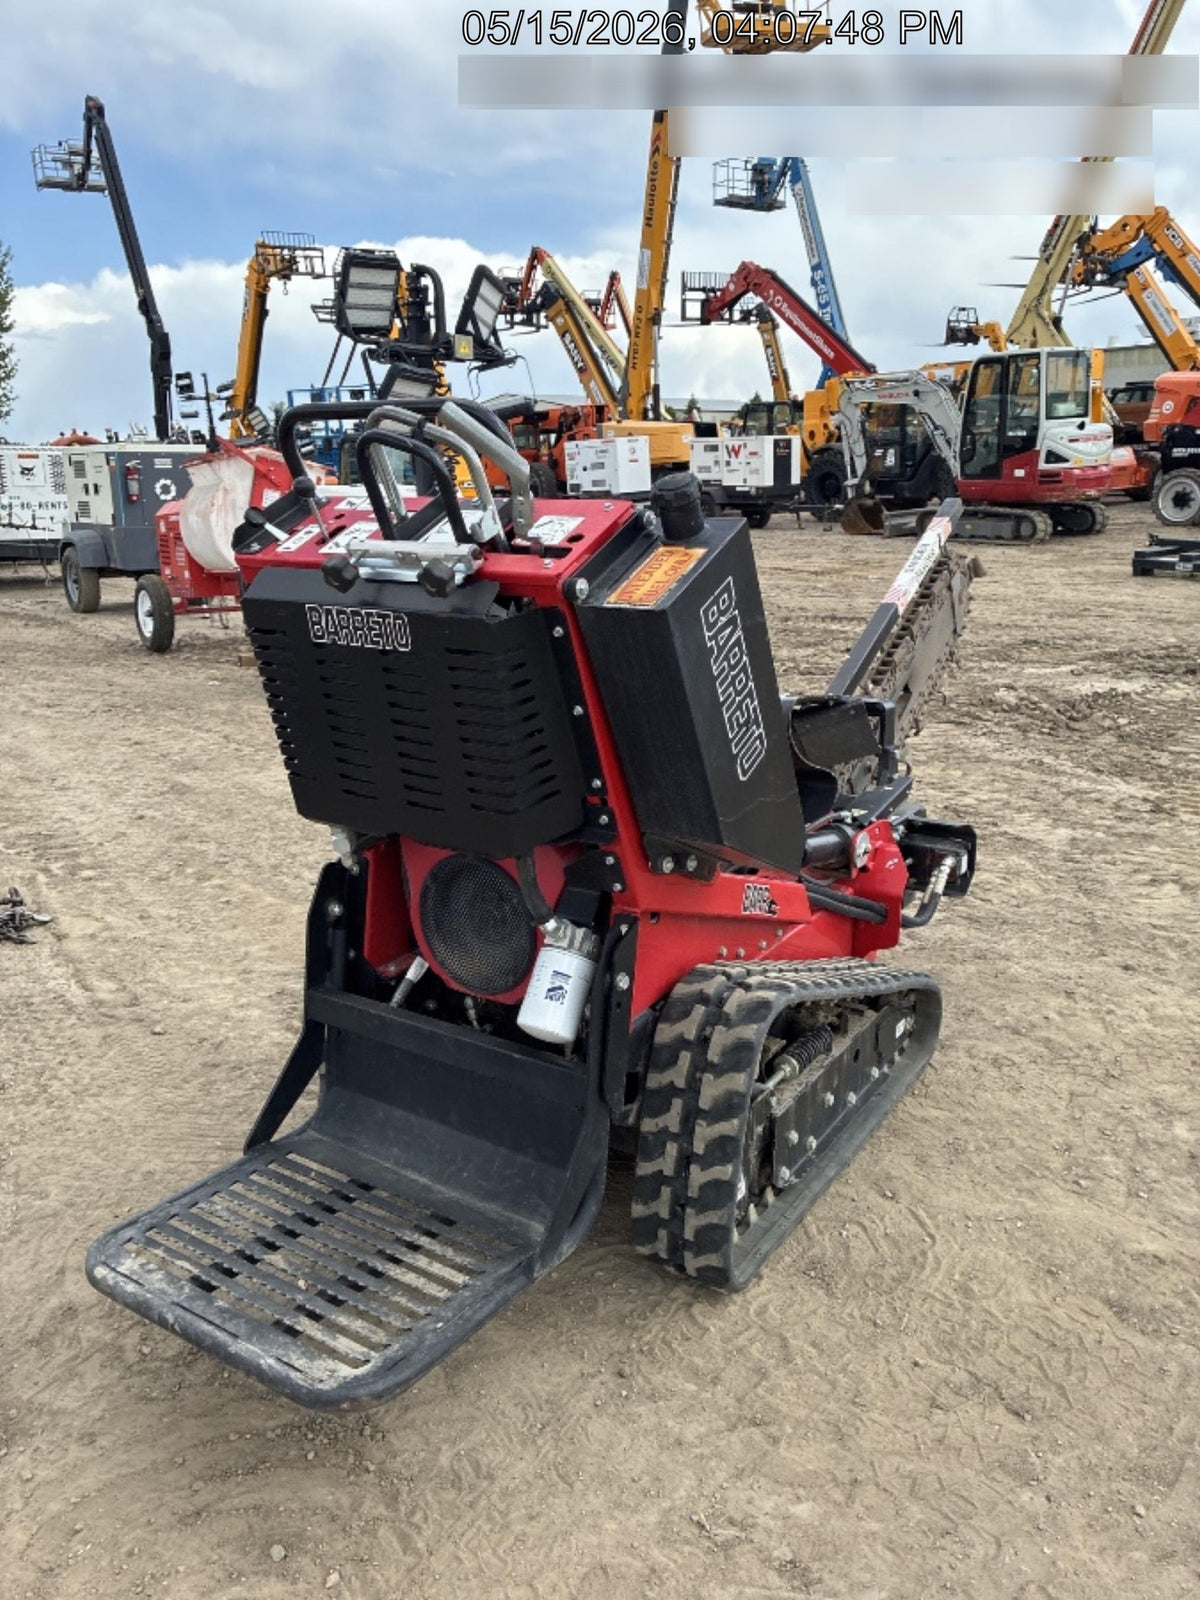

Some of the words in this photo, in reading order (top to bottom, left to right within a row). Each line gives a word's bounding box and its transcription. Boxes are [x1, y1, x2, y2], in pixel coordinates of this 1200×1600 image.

[645, 160, 660, 228] Haulotte
[1163, 226, 1184, 250] JCB
[780, 301, 836, 360] EquipmentShare
[618, 550, 674, 602] UNLEADED
[639, 580, 669, 603] FUEL
[664, 551, 695, 583] ONLY
[304, 603, 412, 652] BARRETO
[700, 576, 767, 781] BARRETO
